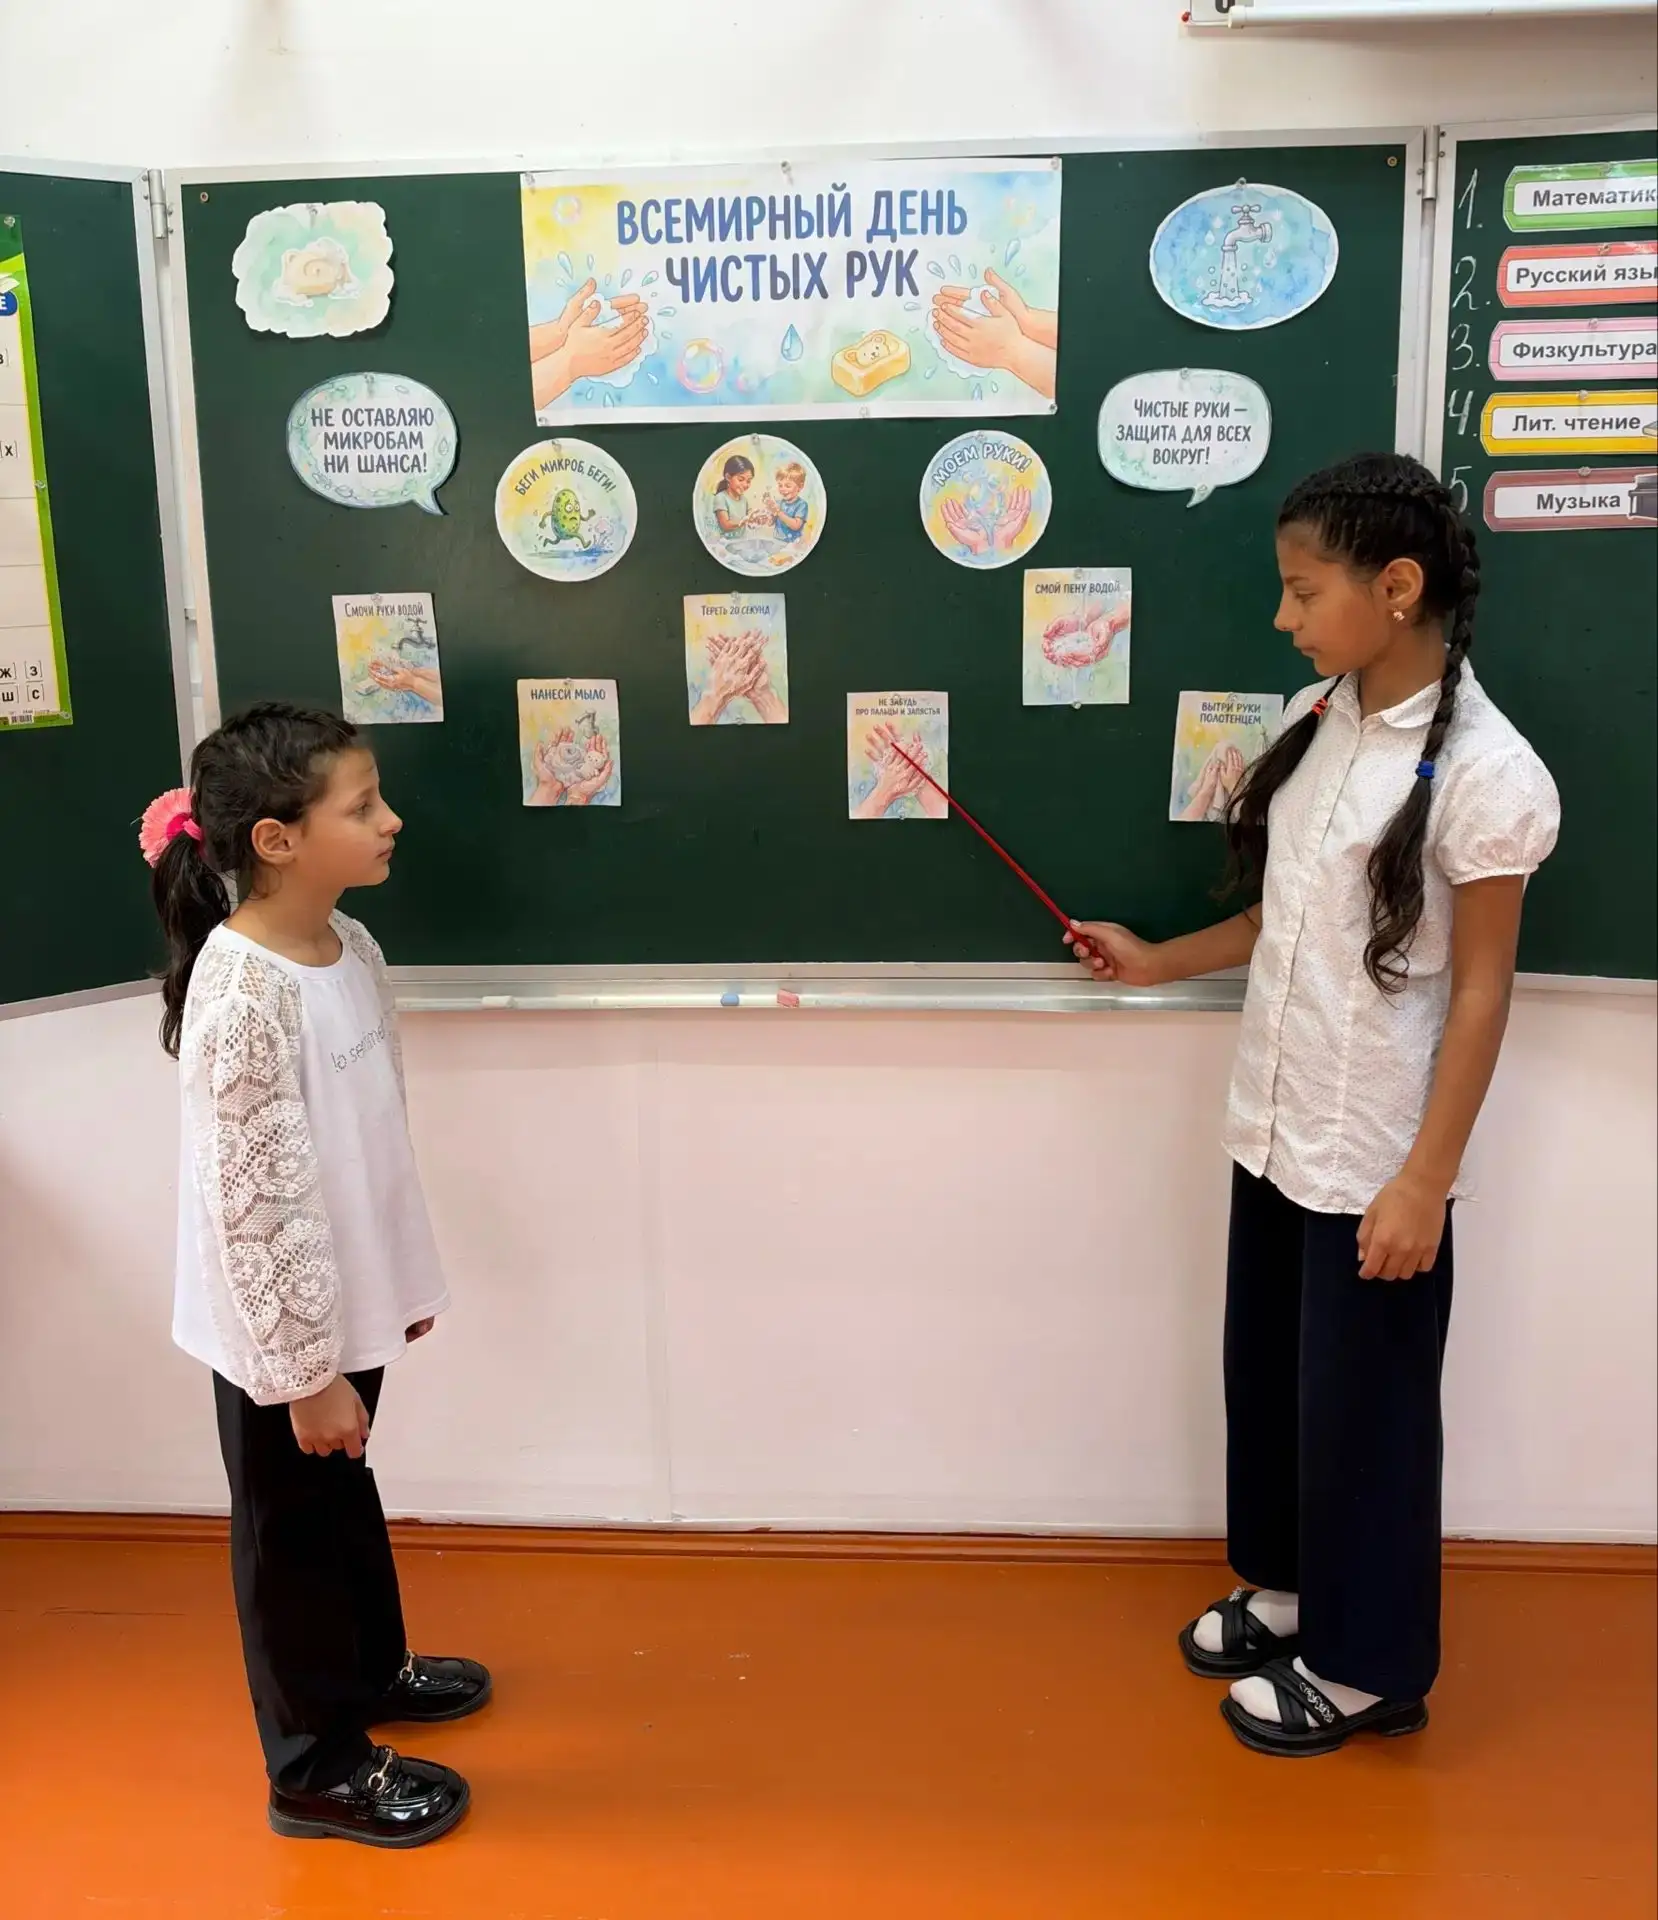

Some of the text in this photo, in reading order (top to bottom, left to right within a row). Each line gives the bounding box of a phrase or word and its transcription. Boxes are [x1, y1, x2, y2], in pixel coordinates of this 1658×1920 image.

[1458, 168, 1483, 229] 1.
[1533, 188, 1656, 207] Математик
[617, 182, 968, 245] ВСЕМИРНЫЙ ДЕНЬ
[665, 249, 919, 303] ЧИСТЫХ РУК
[1452, 255, 1491, 311] 2.
[1516, 265, 1607, 288] Русский
[1451, 323, 1481, 371] 3.
[1513, 342, 1657, 362] Физкультура
[311, 407, 434, 428] НЕ ОСТАВЛЯЮ
[1194, 401, 1230, 418] РУКИ
[1448, 389, 1477, 437] 4.
[1512, 415, 1641, 432] Лит. чтение
[323, 431, 424, 450] МИКРОБАМ
[1116, 424, 1251, 444] ЗАЩИТА ДЛЯ ВСЕХ
[324, 452, 428, 473] НИ ШАНСА!
[932, 442, 1032, 488] МОЕМ РУКИ!
[1153, 447, 1210, 465] ВОКРУГ!
[514, 458, 617, 496] БЕГИ МИКРОБ, БЕГИ!
[1536, 493, 1621, 513] Музыка
[1035, 580, 1120, 594] СМОЙ ПЕНУ ВОДОЙ
[730, 605, 740, 615] 20
[741, 605, 770, 616] СЕКУНД
[530, 688, 606, 700] НАНЕСИ МЫЛО
[878, 697, 917, 707] НЕ ЗАБУДЬ
[870, 708, 899, 717] ПАЛЬЦЫ
[907, 708, 940, 716] ЗАПЯСТЬЯ
[1201, 702, 1261, 713] ВЫТРИ РУКИ
[1200, 712, 1262, 726] ПОЛОТЕНЦЕМ
